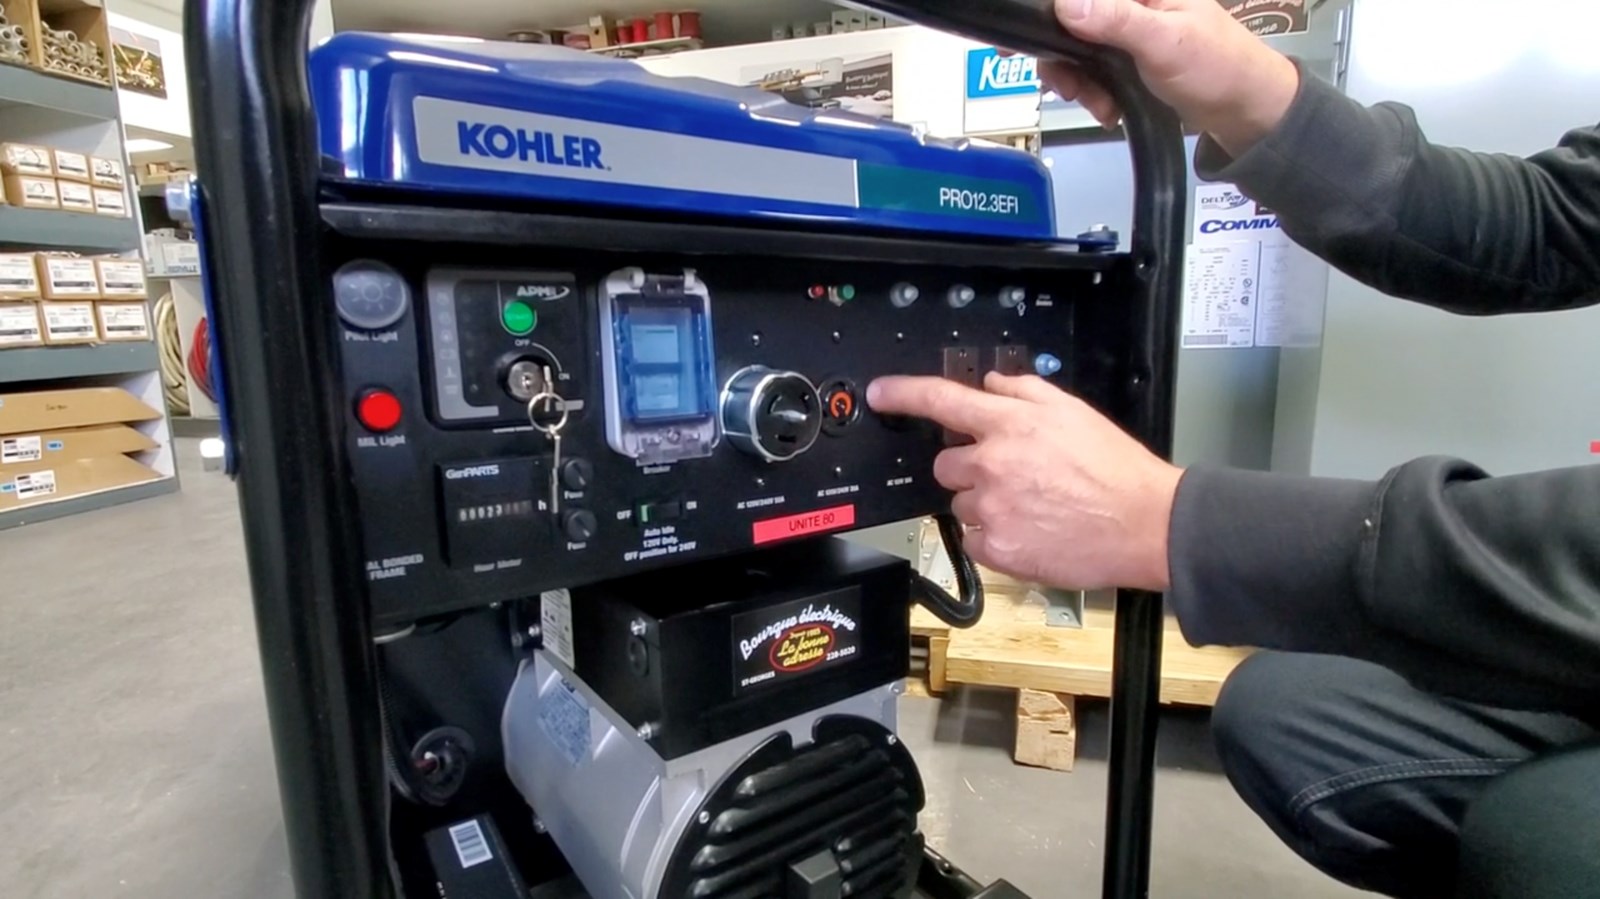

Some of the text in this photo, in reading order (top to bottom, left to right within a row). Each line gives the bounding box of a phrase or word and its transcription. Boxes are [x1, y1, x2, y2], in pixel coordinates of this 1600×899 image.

[457, 120, 606, 170] KOHLER
[940, 187, 1019, 214] PRO12.3EFI
[514, 339, 530, 347] OFF
[558, 372, 571, 381] ON
[380, 435, 406, 447] Light
[445, 464, 499, 479] GenPARTS
[616, 510, 632, 520] OFF
[789, 512, 835, 531] UNITE 80
[624, 550, 638, 561] OFF
